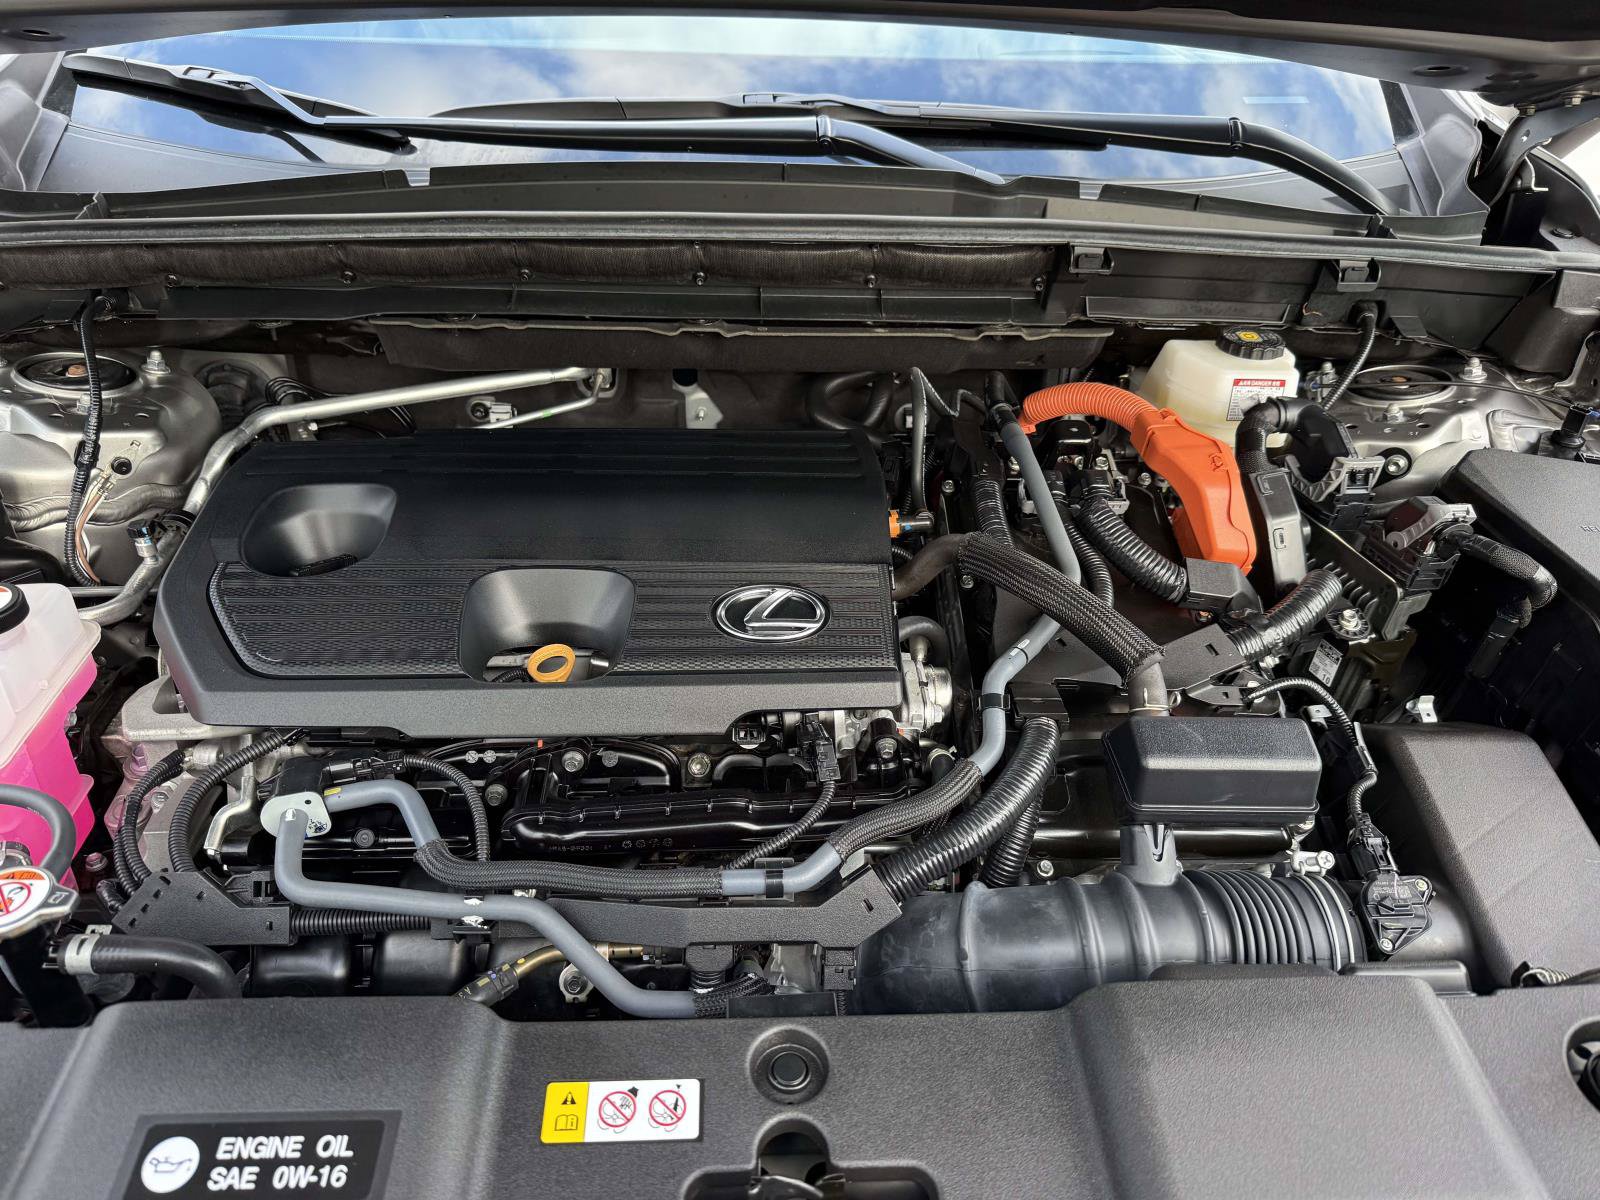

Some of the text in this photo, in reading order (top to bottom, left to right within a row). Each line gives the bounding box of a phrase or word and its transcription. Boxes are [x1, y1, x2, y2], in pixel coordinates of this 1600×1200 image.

[215, 1134, 354, 1160] ENGINE OIL
[206, 1164, 349, 1191] SAE 0W-16
